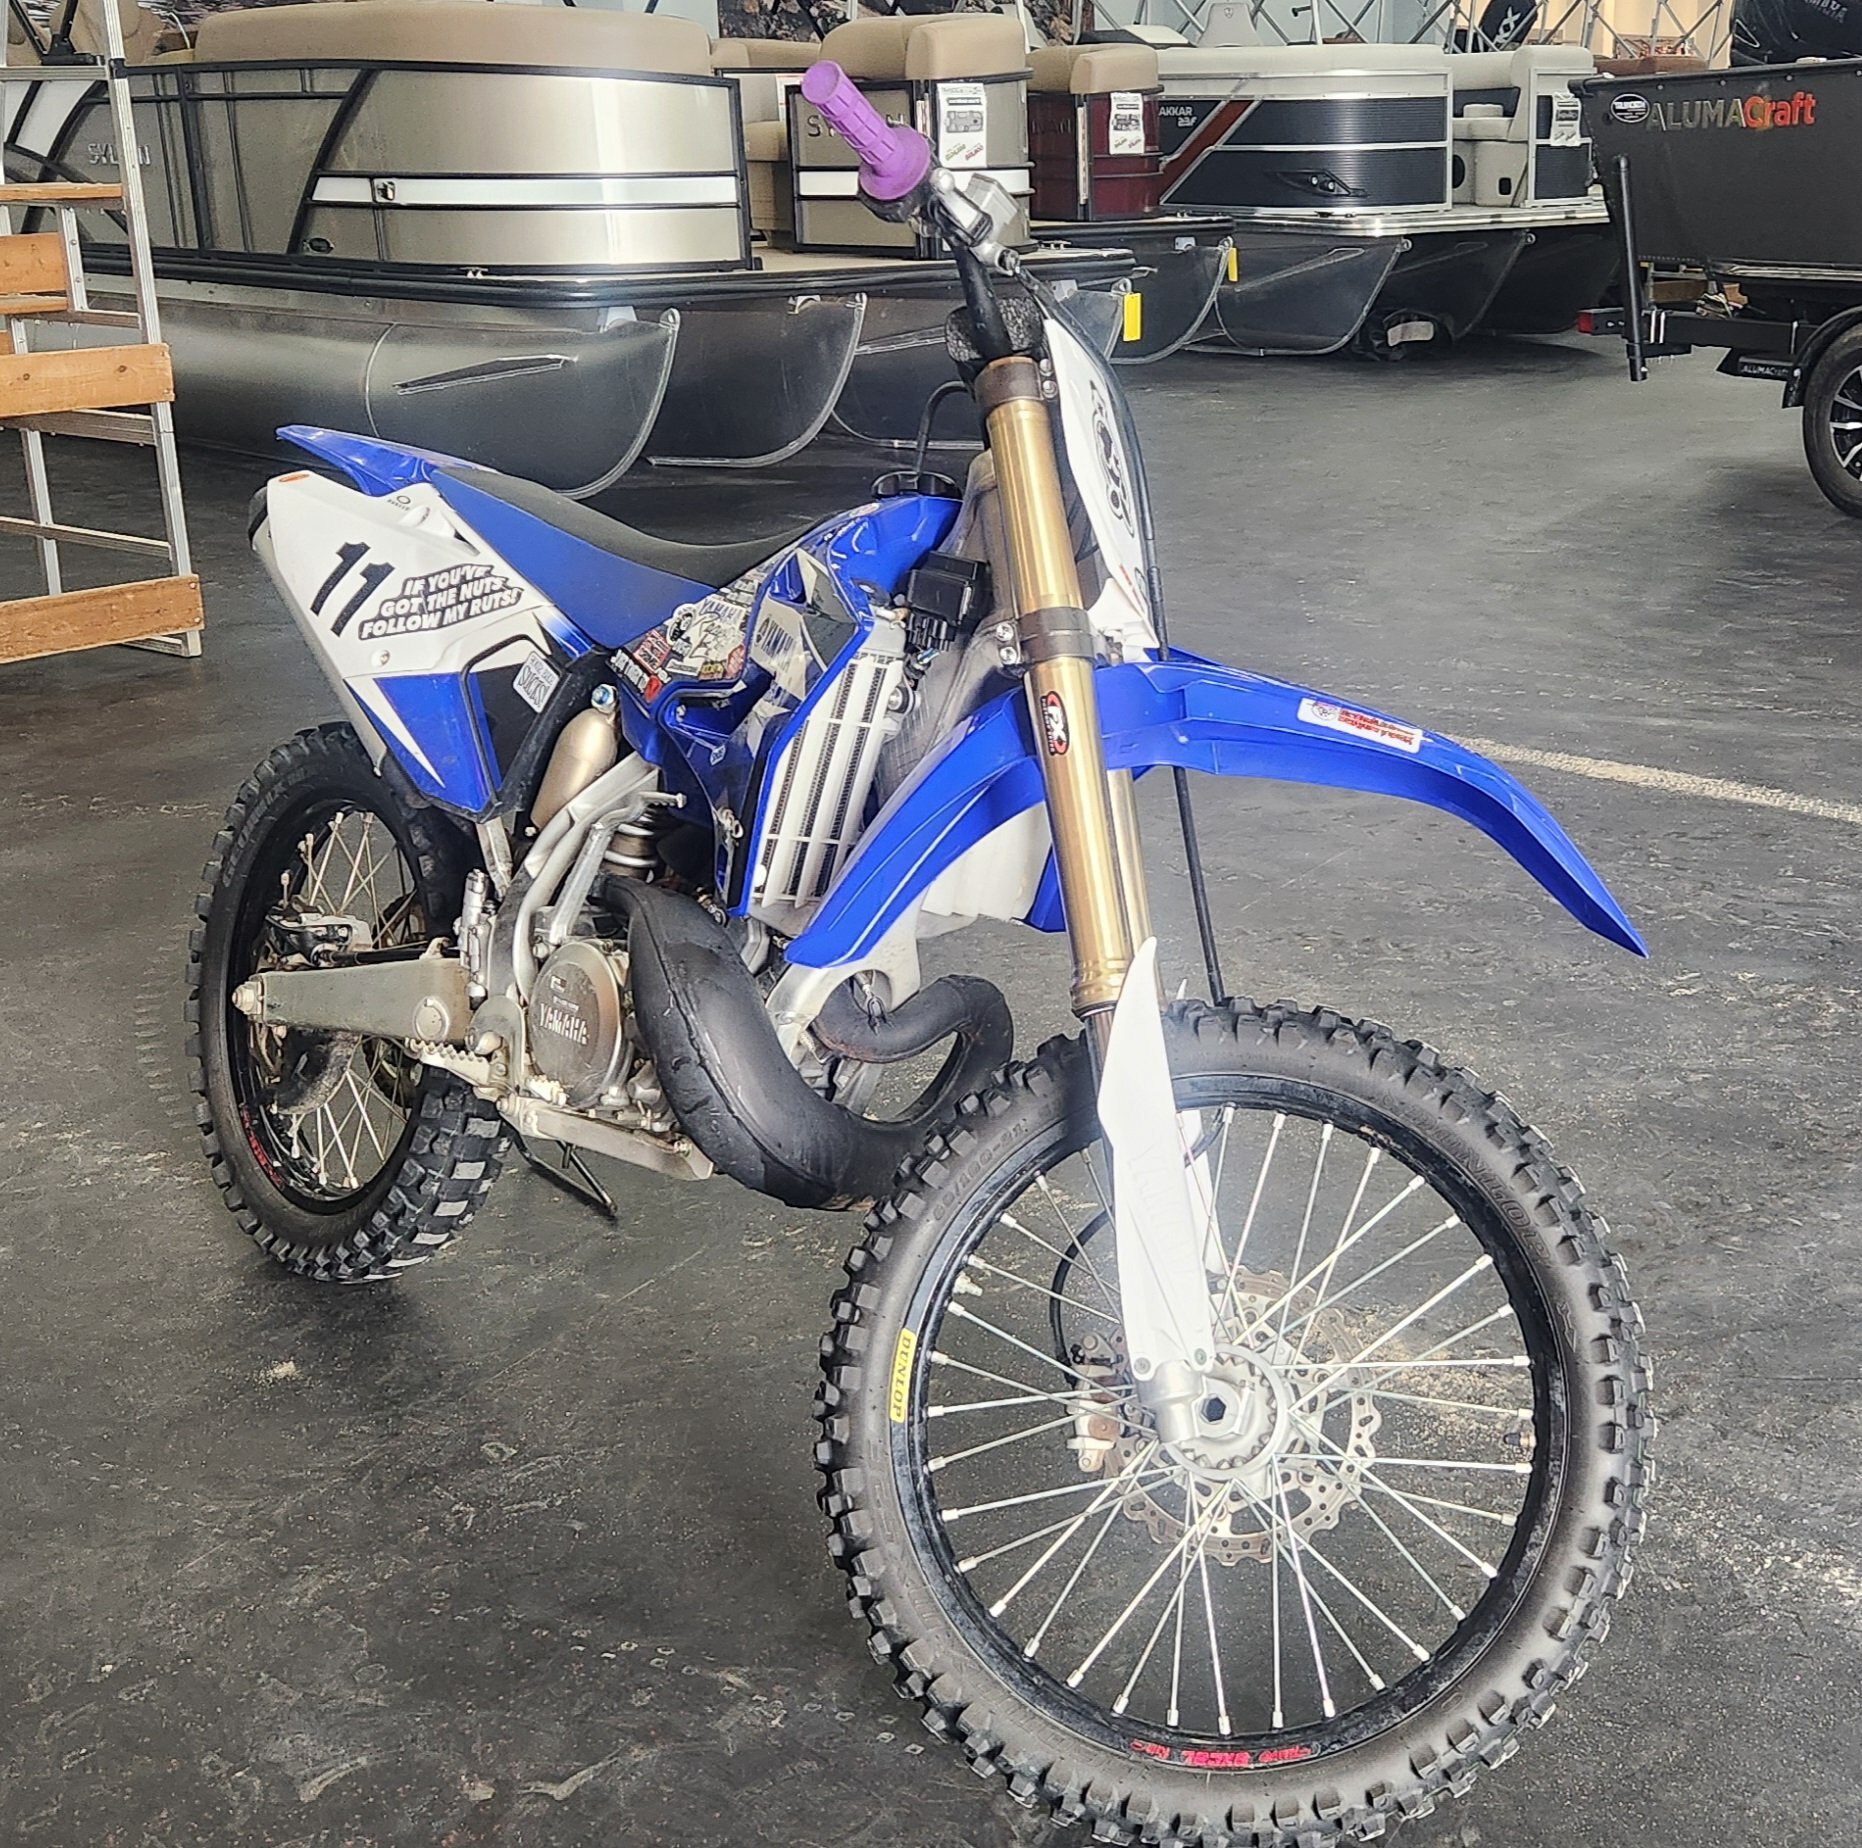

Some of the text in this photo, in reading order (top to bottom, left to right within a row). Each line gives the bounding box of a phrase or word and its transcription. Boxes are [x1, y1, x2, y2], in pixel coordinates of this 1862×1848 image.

[88, 143, 151, 166] SYLN
[310, 541, 396, 637] 11
[380, 596, 426, 617] GOT
[426, 588, 458, 612] THE
[403, 578, 426, 596] IF
[361, 586, 524, 640] FOLLOW MY RUTS!
[539, 1002, 590, 1045] YAMAHA
[893, 1336, 911, 1418] DUNLOP
